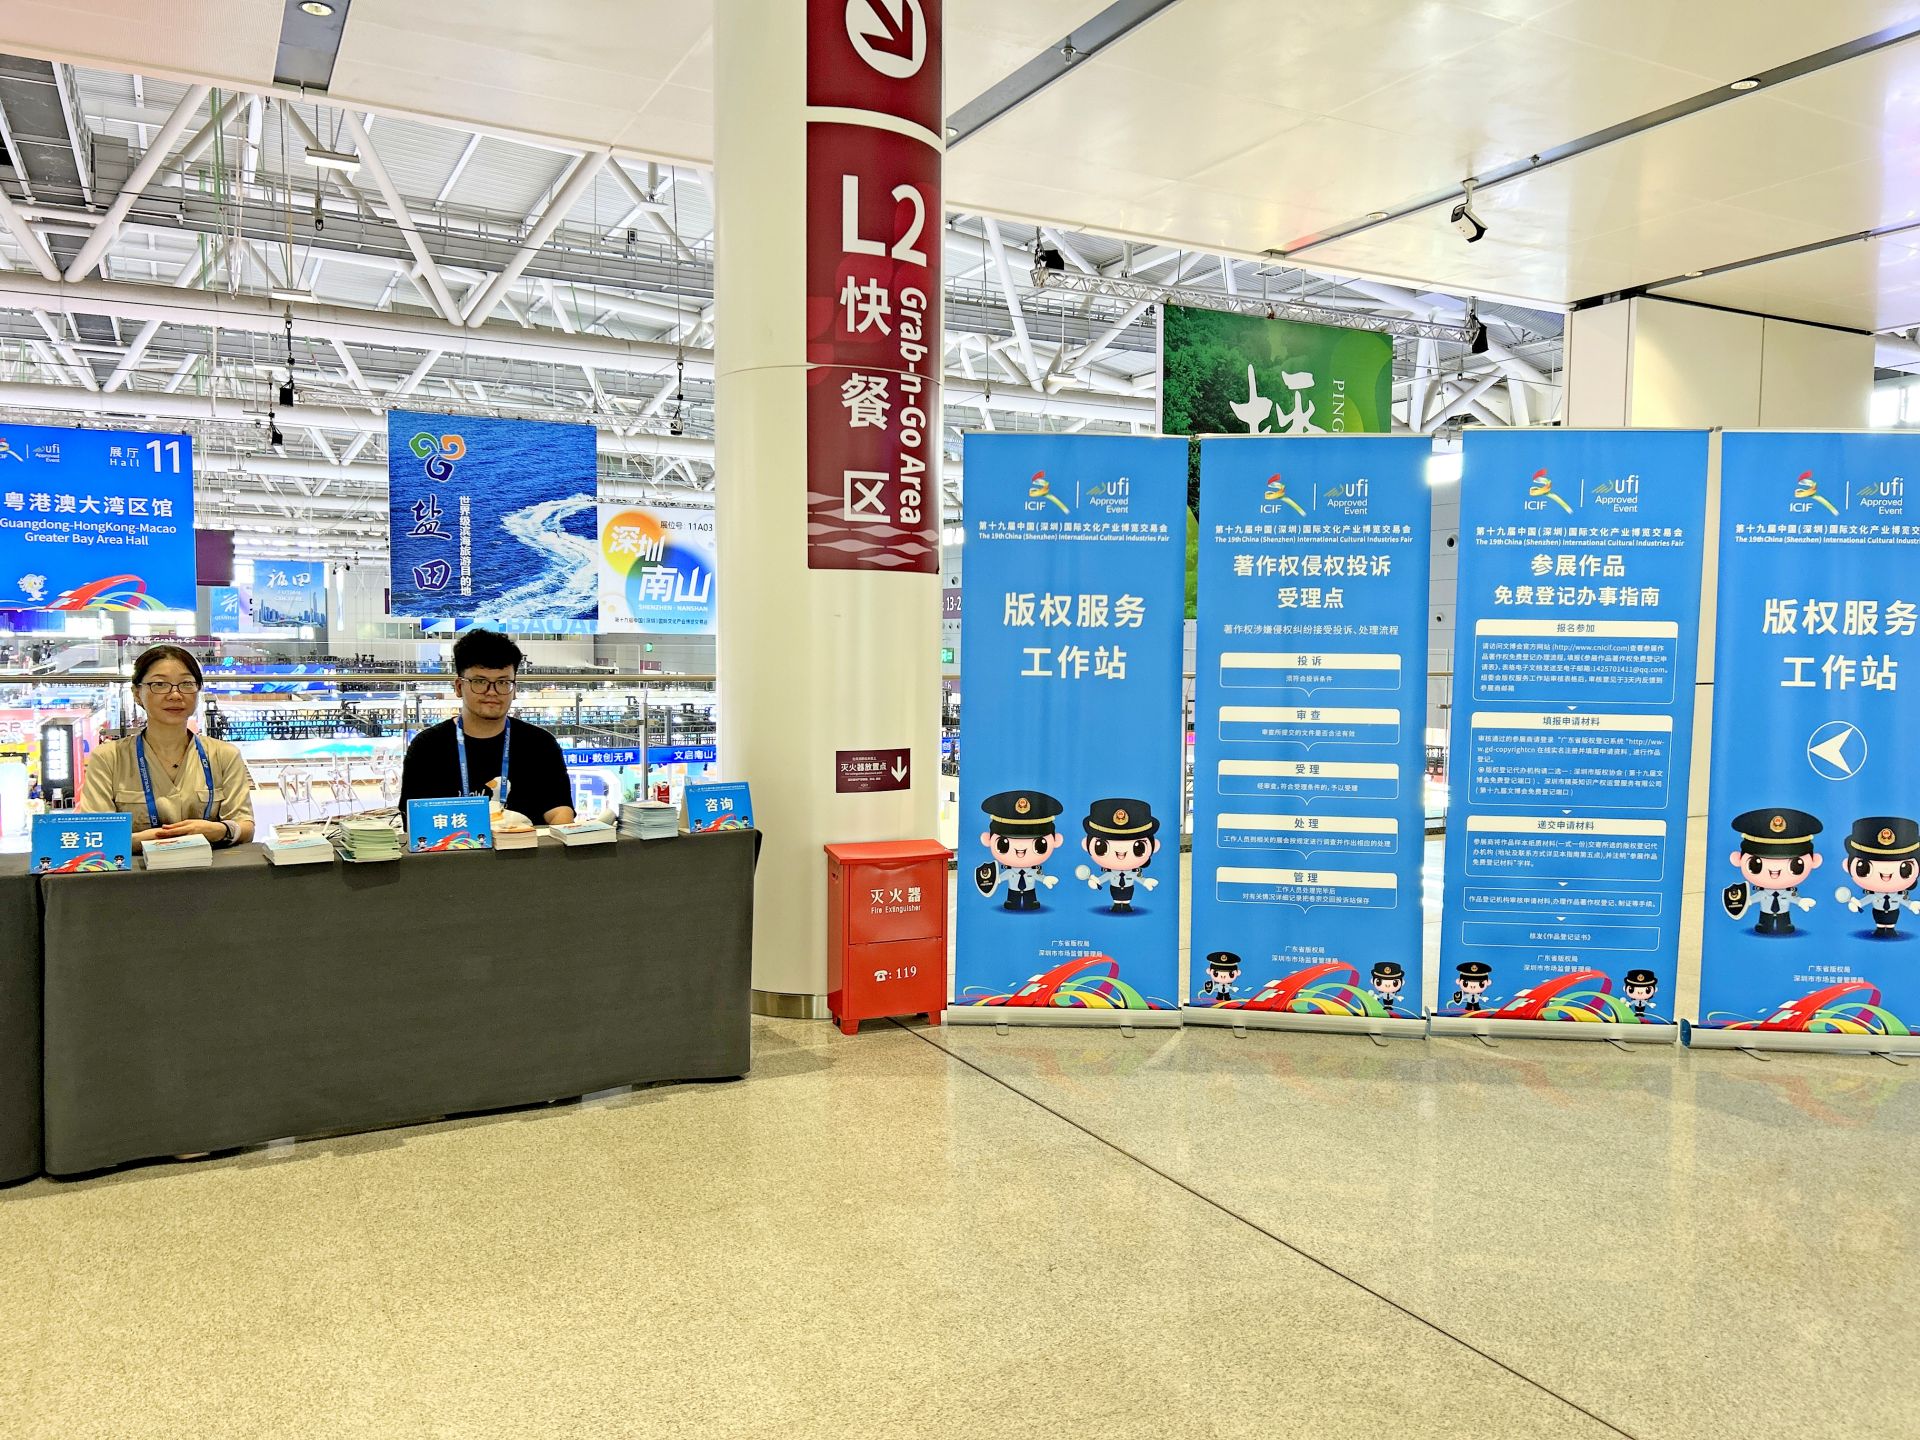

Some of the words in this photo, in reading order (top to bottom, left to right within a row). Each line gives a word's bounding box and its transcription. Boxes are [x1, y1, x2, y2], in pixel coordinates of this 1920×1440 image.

[842, 174, 928, 268] L2
[900, 286, 928, 448] Grab-n-Go
[840, 275, 892, 524] 快餐区
[46, 444, 60, 453] ufi
[110, 446, 139, 458] 展厅
[146, 440, 181, 473] 11
[110, 458, 140, 468] Hall
[899, 453, 926, 525] Area
[1106, 477, 1130, 496] ufi
[1345, 478, 1368, 498] ufi
[1615, 475, 1639, 494] ufi
[1880, 476, 1904, 496] ufi
[4, 492, 173, 518] 粤港澳大湾区馆
[1024, 501, 1046, 510] ICIF
[1089, 497, 1128, 506] Approved
[1328, 498, 1368, 508] Approved
[1524, 501, 1548, 510] ICIF
[1595, 496, 1638, 504] Approved
[1790, 502, 1814, 512] ICIF
[1860, 498, 1903, 507] Approved
[1260, 504, 1282, 514] ICIF
[1344, 507, 1368, 515] Event
[1613, 504, 1638, 513] Event
[1878, 506, 1903, 515] Event
[0, 518, 176, 534] Guangdong-HongKong-Macao
[688, 522, 713, 532] 11A03
[25, 532, 69, 543] Greater
[72, 534, 94, 546] Bay
[97, 535, 123, 545] Area
[126, 536, 149, 546] Hall
[608, 526, 666, 562] 深圳
[1233, 554, 1392, 577] 著作权侵权投诉
[1531, 554, 1625, 577] 参展作品
[638, 564, 712, 604] 南山
[1277, 587, 1344, 609] 受理点
[1494, 585, 1660, 606] 免费登记办事指南
[1004, 592, 1146, 628] 版权服务
[1762, 598, 1918, 636] 版权服务
[1224, 624, 1399, 636] 著作权涉嫌侵权纠纷接受投诉、处理流程
[1557, 624, 1595, 633] 报名参加
[1020, 645, 1127, 680] 工作站
[1298, 656, 1322, 667] 投诉
[1780, 654, 1898, 691] 工作站
[1296, 710, 1321, 721] 审查
[1543, 717, 1600, 726] 填报申请材料
[841, 762, 887, 772] 灭火器放置点
[1296, 764, 1320, 774] 受理
[705, 797, 734, 812] 咨询
[433, 813, 468, 829] 审核
[1294, 818, 1319, 829] 处理
[1538, 820, 1595, 830] 递交申请材料
[60, 832, 103, 849] 登记
[1294, 872, 1318, 883] 管理
[870, 887, 922, 905] 灭火器
[871, 906, 882, 914] Fire
[885, 904, 921, 914] Extinguisher
[896, 966, 917, 980] 119
